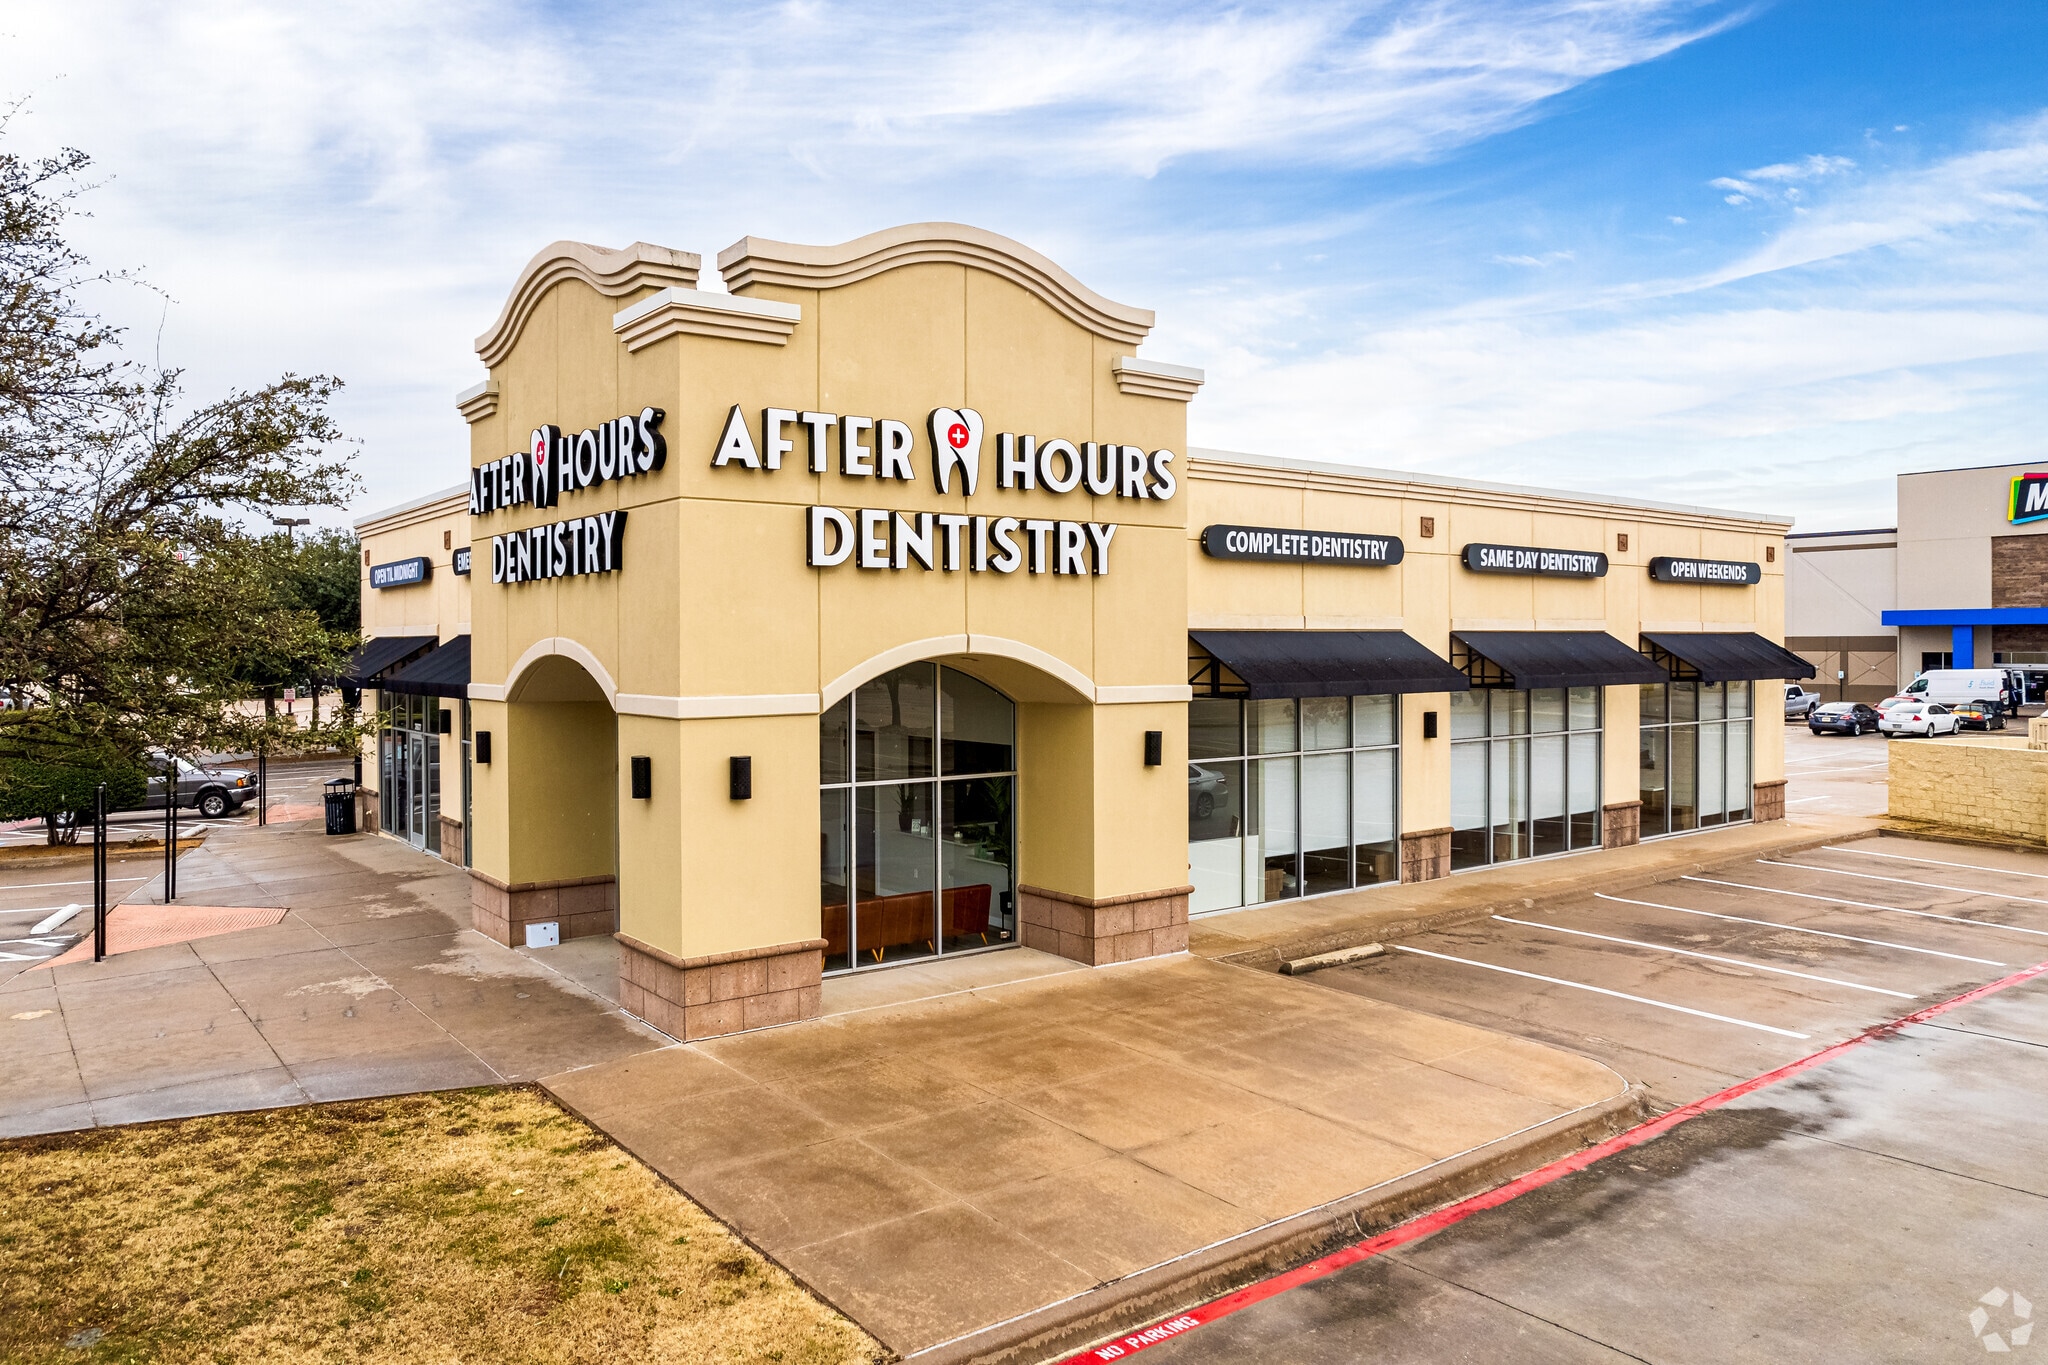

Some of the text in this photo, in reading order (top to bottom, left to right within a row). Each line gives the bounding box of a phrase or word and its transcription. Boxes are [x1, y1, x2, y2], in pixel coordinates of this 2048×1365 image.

[468, 406, 665, 515] AFTER HOURS
[711, 403, 1178, 500] AFTER HOURS
[491, 509, 626, 585] DENTISTRY
[805, 505, 1119, 576] DENTISTRY
[1225, 530, 1389, 561] COMPLETE DENTISTRY
[1480, 548, 1599, 573] SAME DAY DENTISTRY
[374, 568, 387, 585] OPEN
[393, 561, 419, 582] MIDNIGHT
[1670, 560, 1747, 581] OPEN WEEKENDS
[1095, 1315, 1200, 1361] NO PARKING
